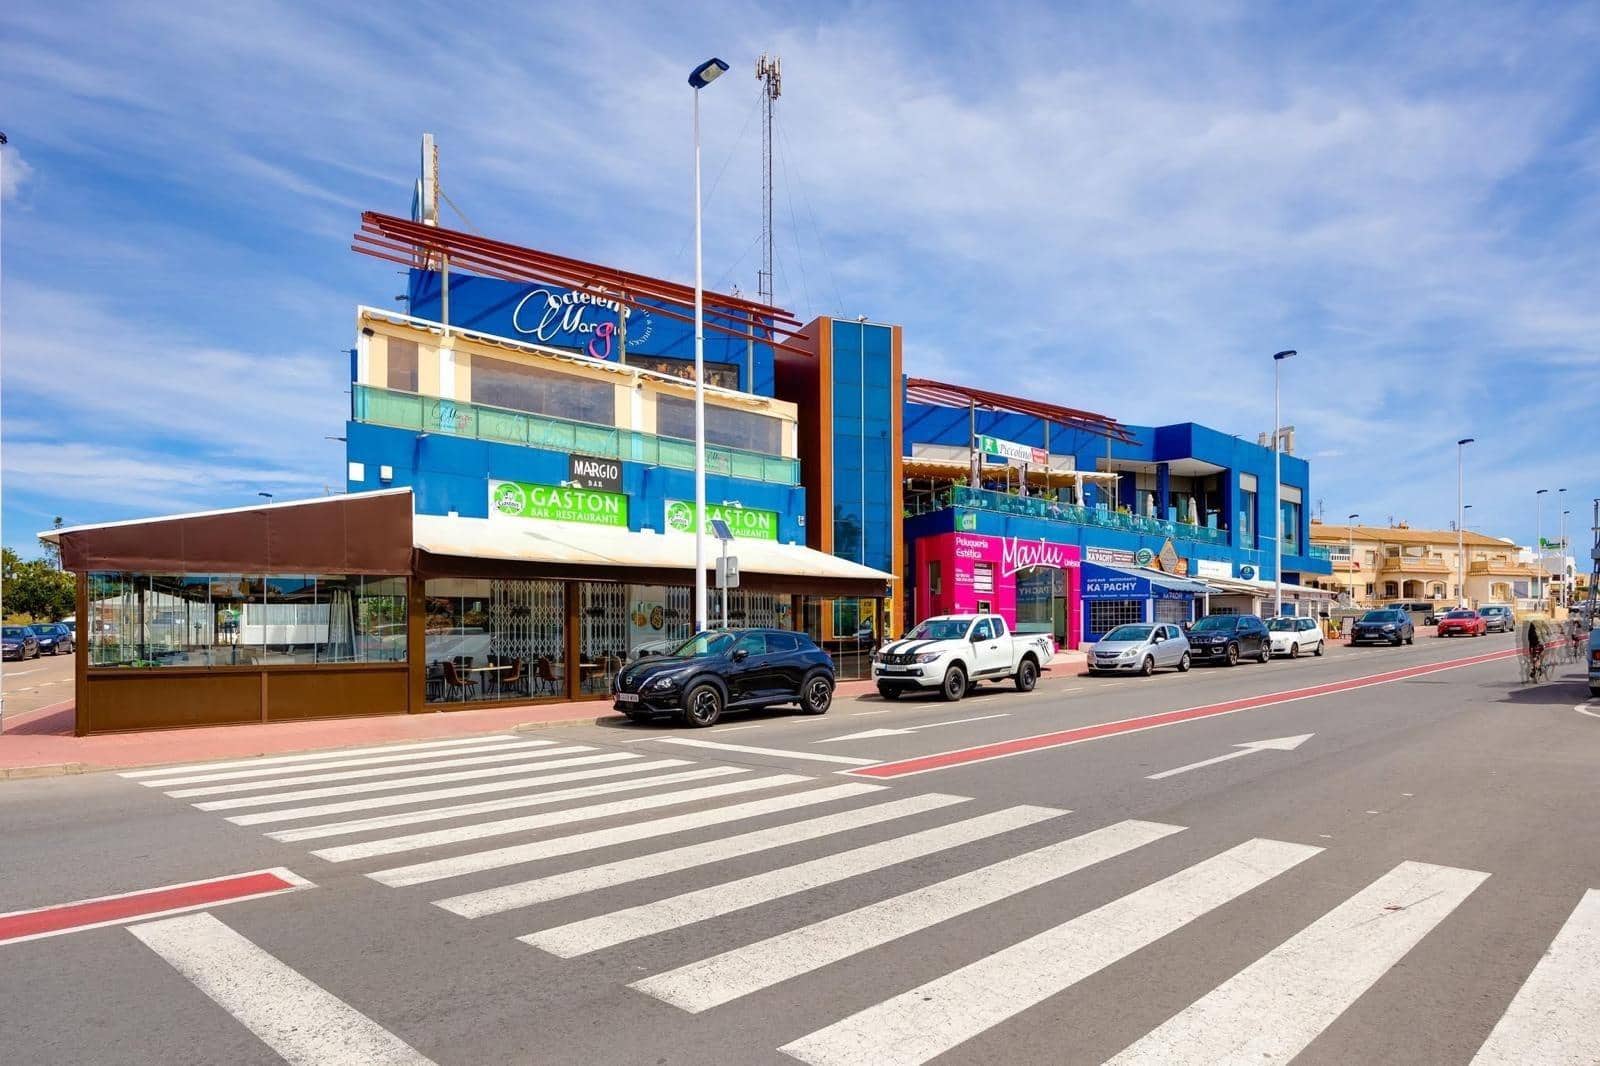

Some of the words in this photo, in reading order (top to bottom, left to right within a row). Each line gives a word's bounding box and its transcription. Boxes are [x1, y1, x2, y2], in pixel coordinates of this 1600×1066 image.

[574, 460, 618, 480] MARGIO
[531, 487, 619, 514] GASTON
[531, 508, 550, 518] BAR
[556, 510, 619, 525] RESTAURANTE
[704, 506, 770, 529] ASTON
